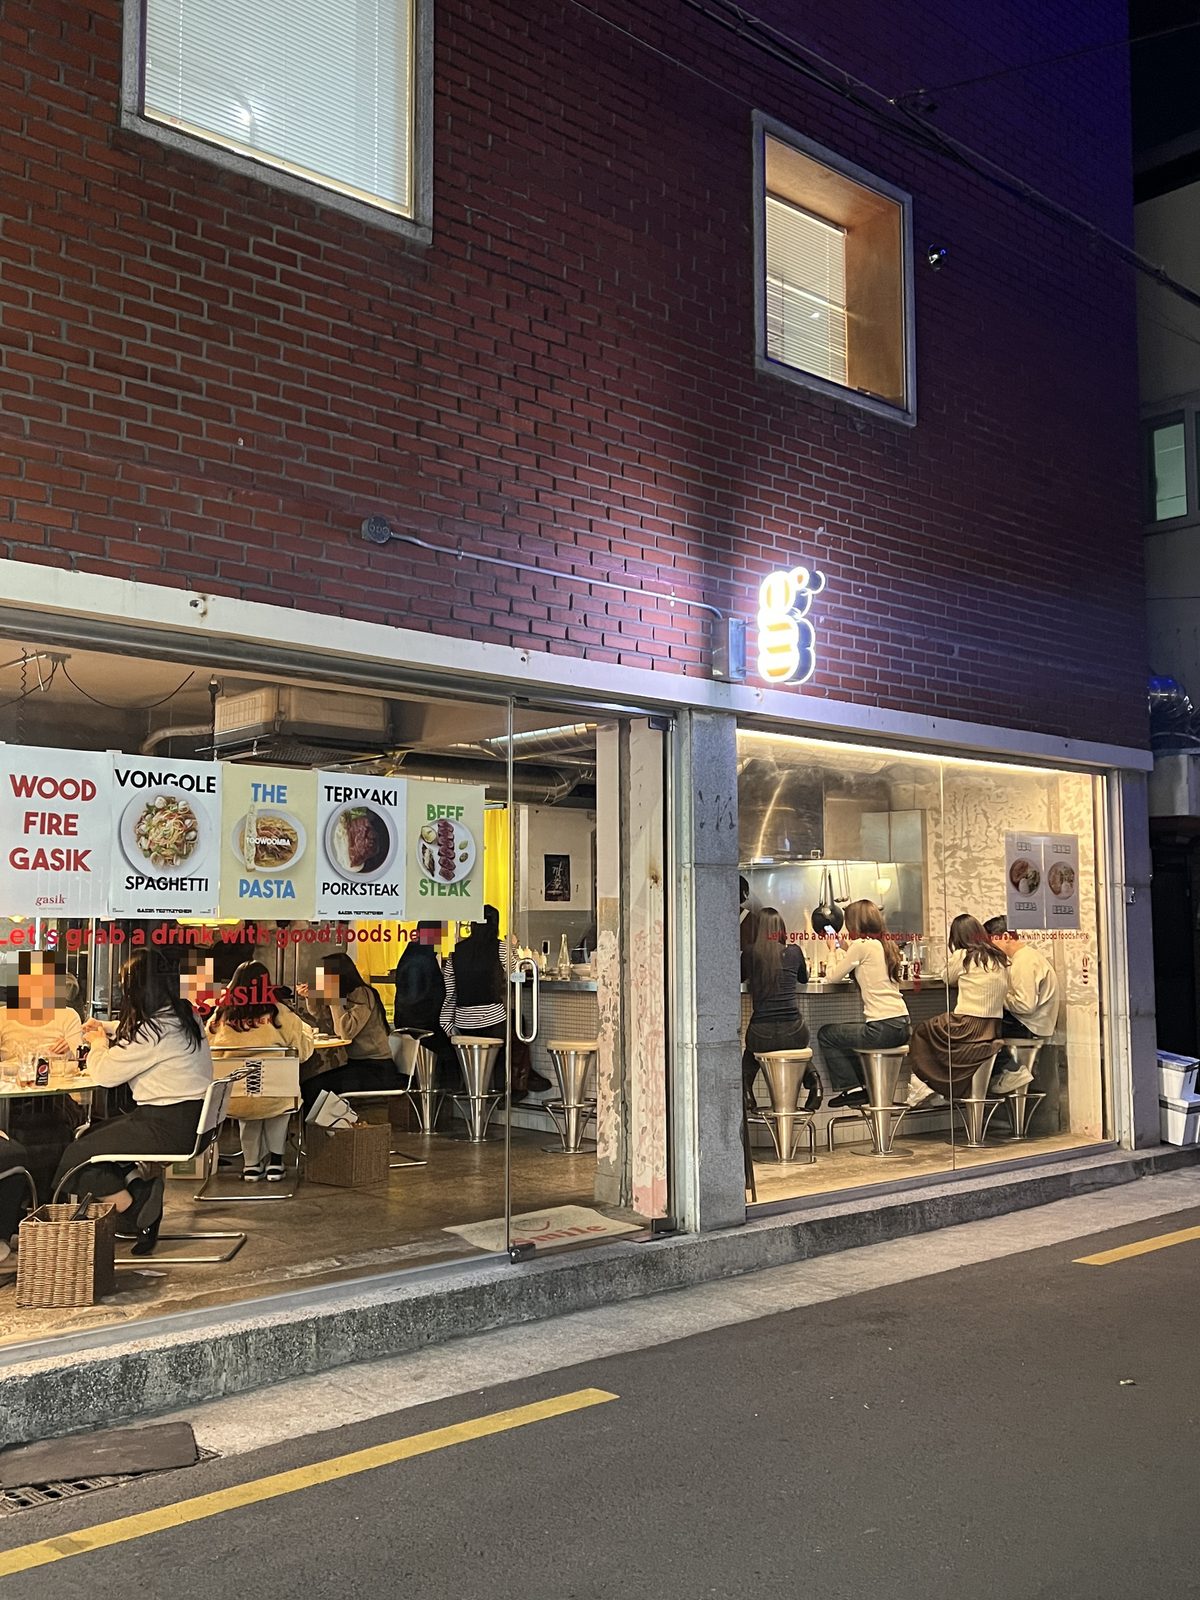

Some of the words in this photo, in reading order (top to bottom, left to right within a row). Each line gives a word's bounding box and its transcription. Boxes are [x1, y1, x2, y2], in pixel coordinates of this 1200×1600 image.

[9, 774, 97, 801] WOOD
[114, 769, 217, 793] VONGOLE
[251, 783, 287, 803] THE
[324, 785, 398, 806] TERIYAKI
[427, 804, 464, 821] BEEF
[23, 811, 79, 836] FIRE
[9, 847, 92, 872] GASIK
[125, 876, 209, 891] SPAGHETTI
[239, 879, 295, 898] PASTA
[322, 882, 400, 896] PORKSTEAK
[419, 879, 471, 897] STEAK
[35, 894, 65, 906] gasik
[66, 922, 126, 950] grab
[132, 928, 145, 945] a
[152, 922, 213, 945] drink
[221, 923, 269, 945] with
[276, 923, 331, 948] good
[336, 923, 391, 943] foods
[790, 930, 809, 943] grab
[811, 932, 816, 940] a
[1027, 930, 1041, 940] with
[1042, 930, 1057, 942] good
[1058, 930, 1075, 940] foods
